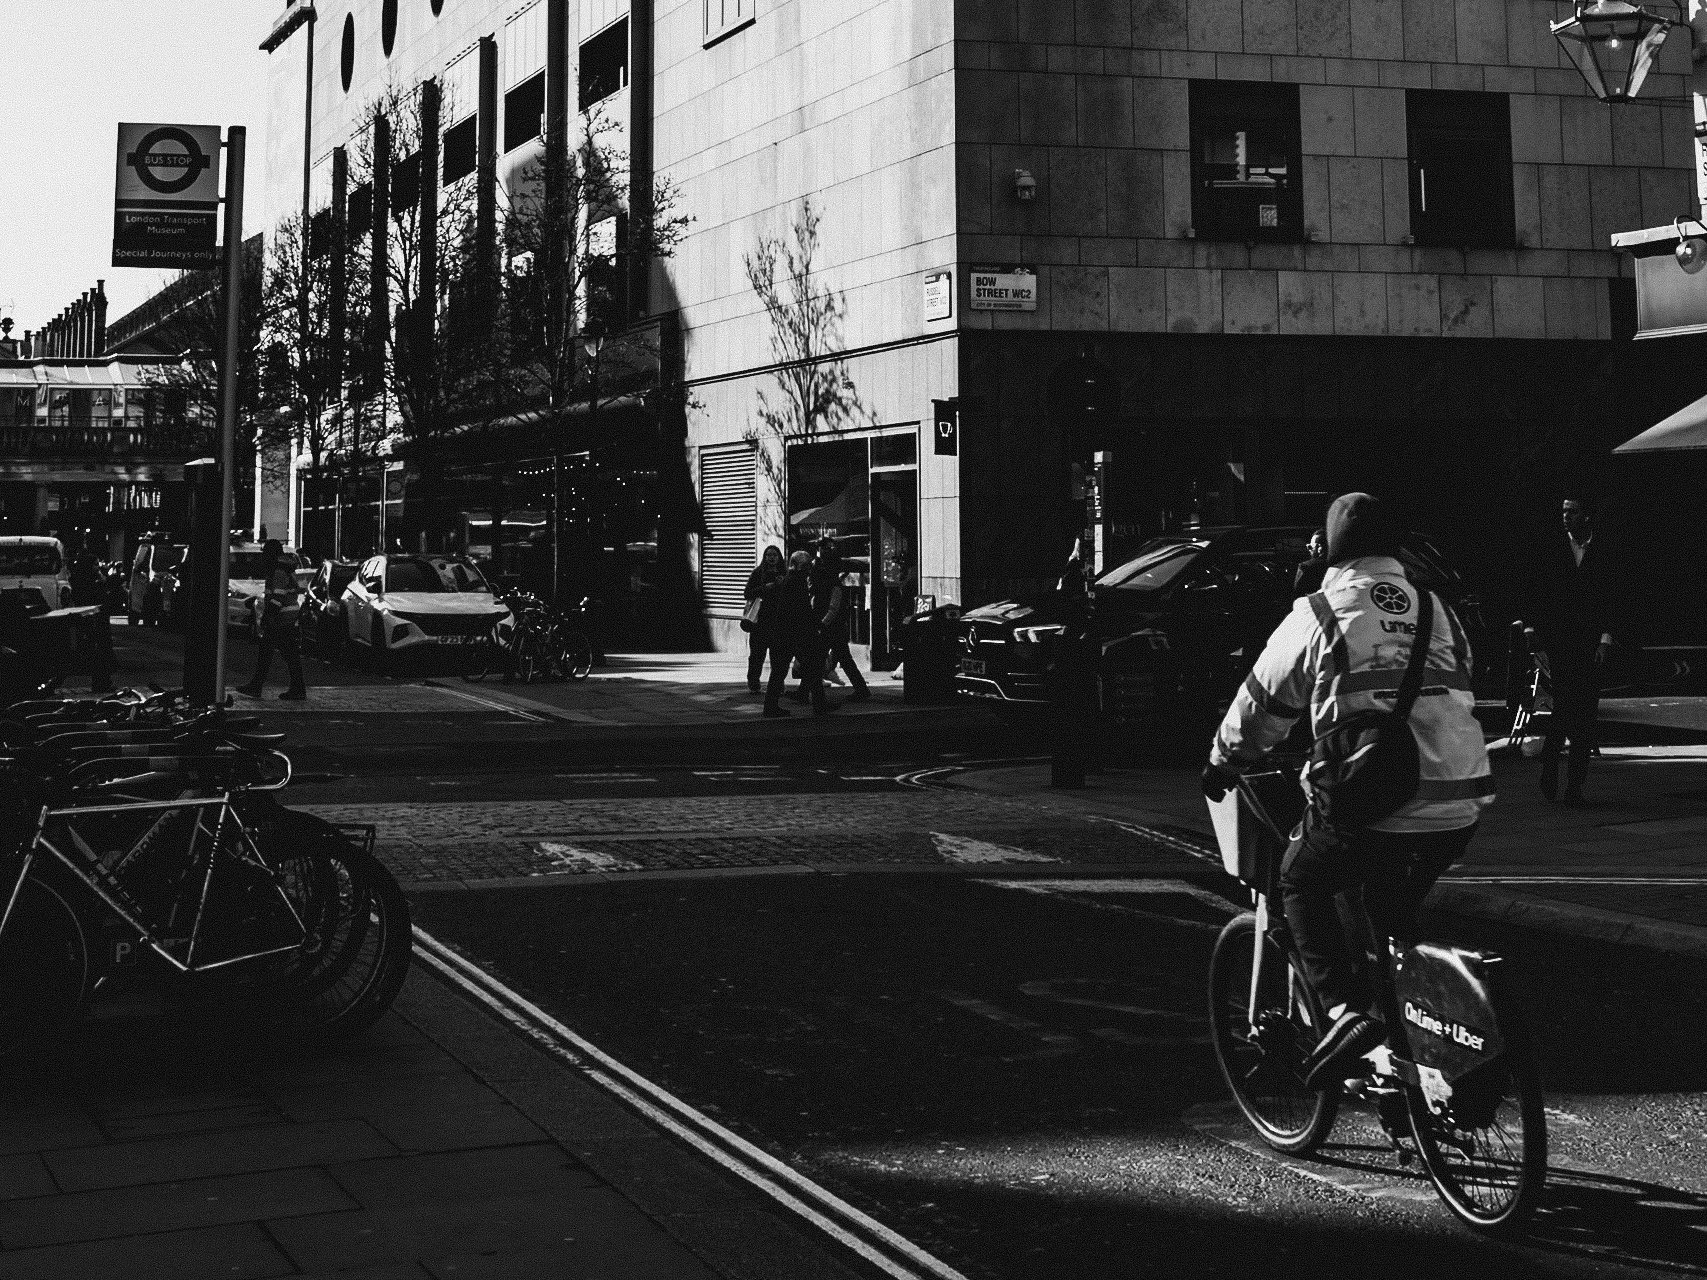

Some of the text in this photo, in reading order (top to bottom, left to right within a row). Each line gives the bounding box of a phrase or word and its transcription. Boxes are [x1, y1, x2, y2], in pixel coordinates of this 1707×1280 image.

[145, 156, 193, 165] BUS STOP
[126, 215, 206, 225] London Transport
[147, 226, 186, 234] Museum
[115, 248, 212, 260] Special Journeys only
[976, 277, 997, 287] BOW
[976, 287, 1031, 299] STREET WC2
[116, 942, 131, 963] P
[1452, 1023, 1485, 1051] Uber
